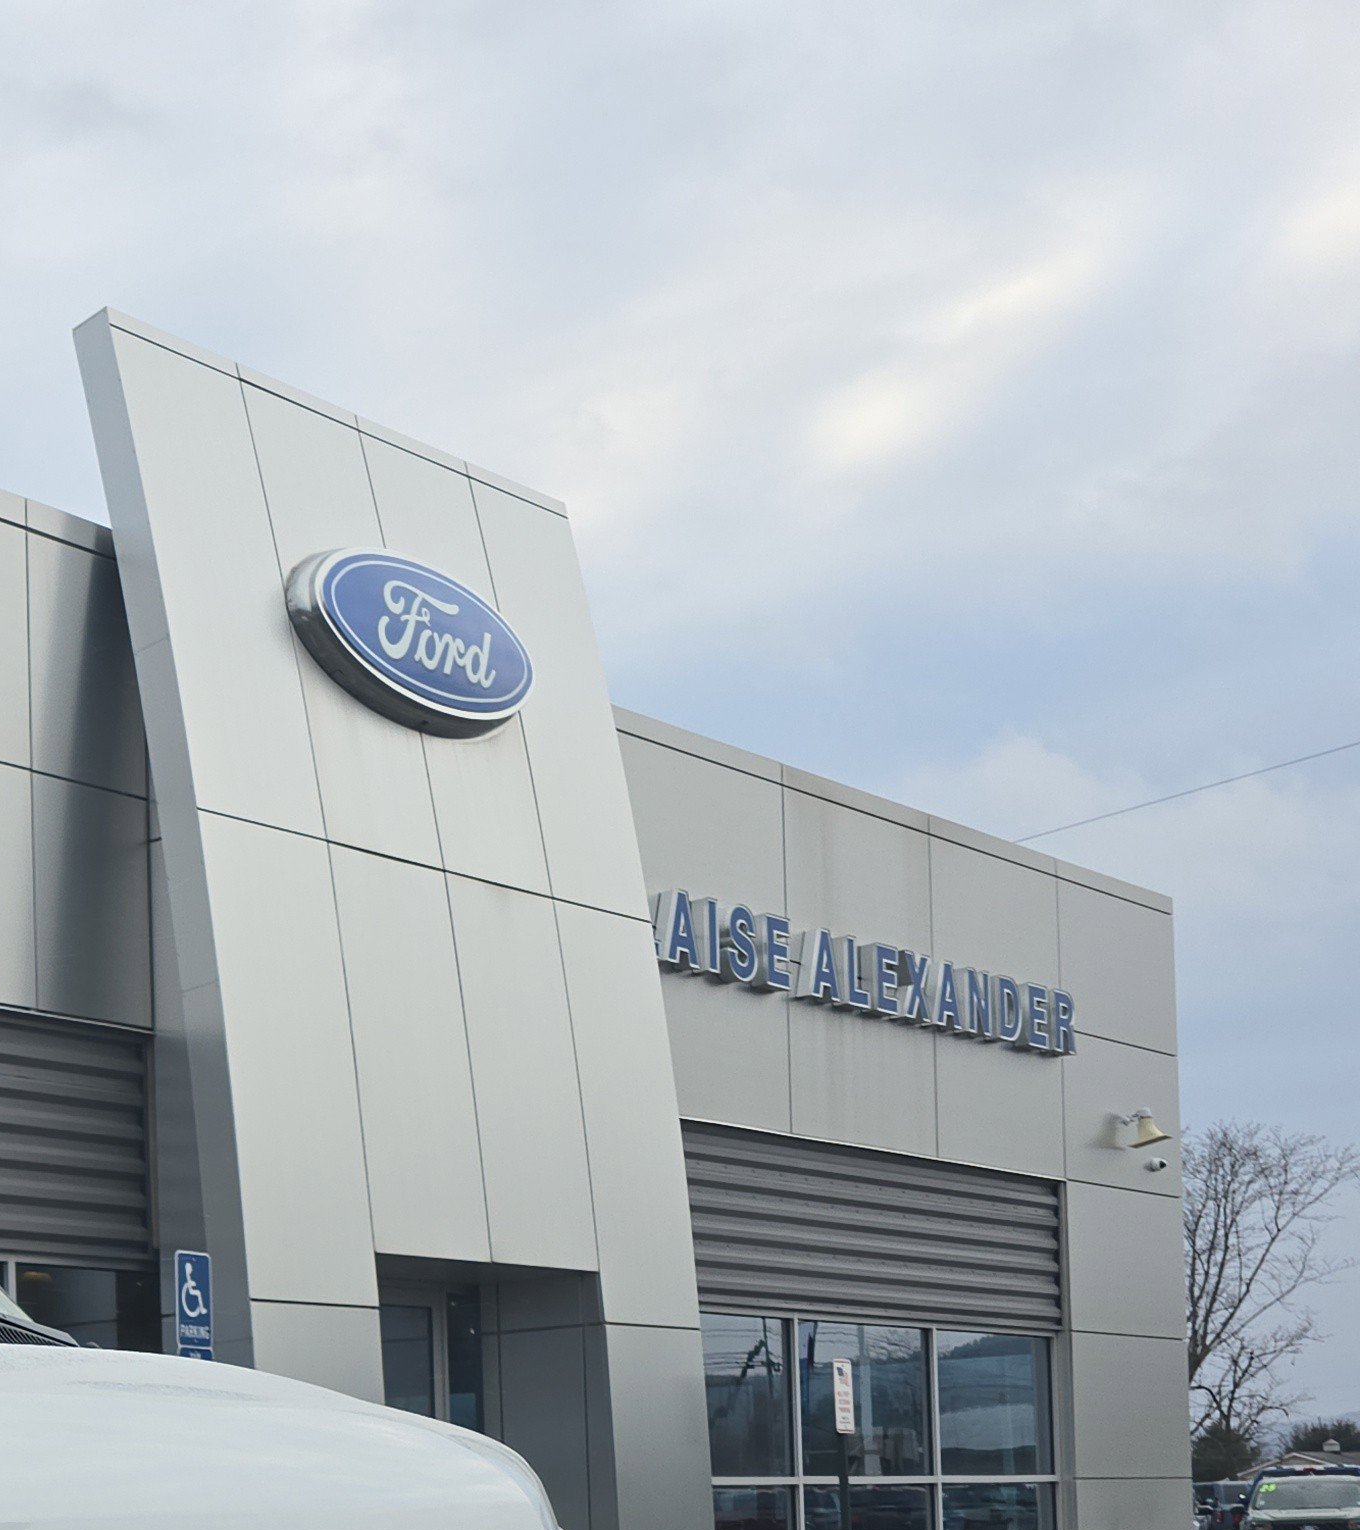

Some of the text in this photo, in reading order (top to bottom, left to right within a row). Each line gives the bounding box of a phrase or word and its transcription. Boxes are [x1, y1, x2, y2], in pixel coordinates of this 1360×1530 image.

[378, 579, 496, 688] Ford
[655, 887, 1077, 1056] AISE ALEXANDER
